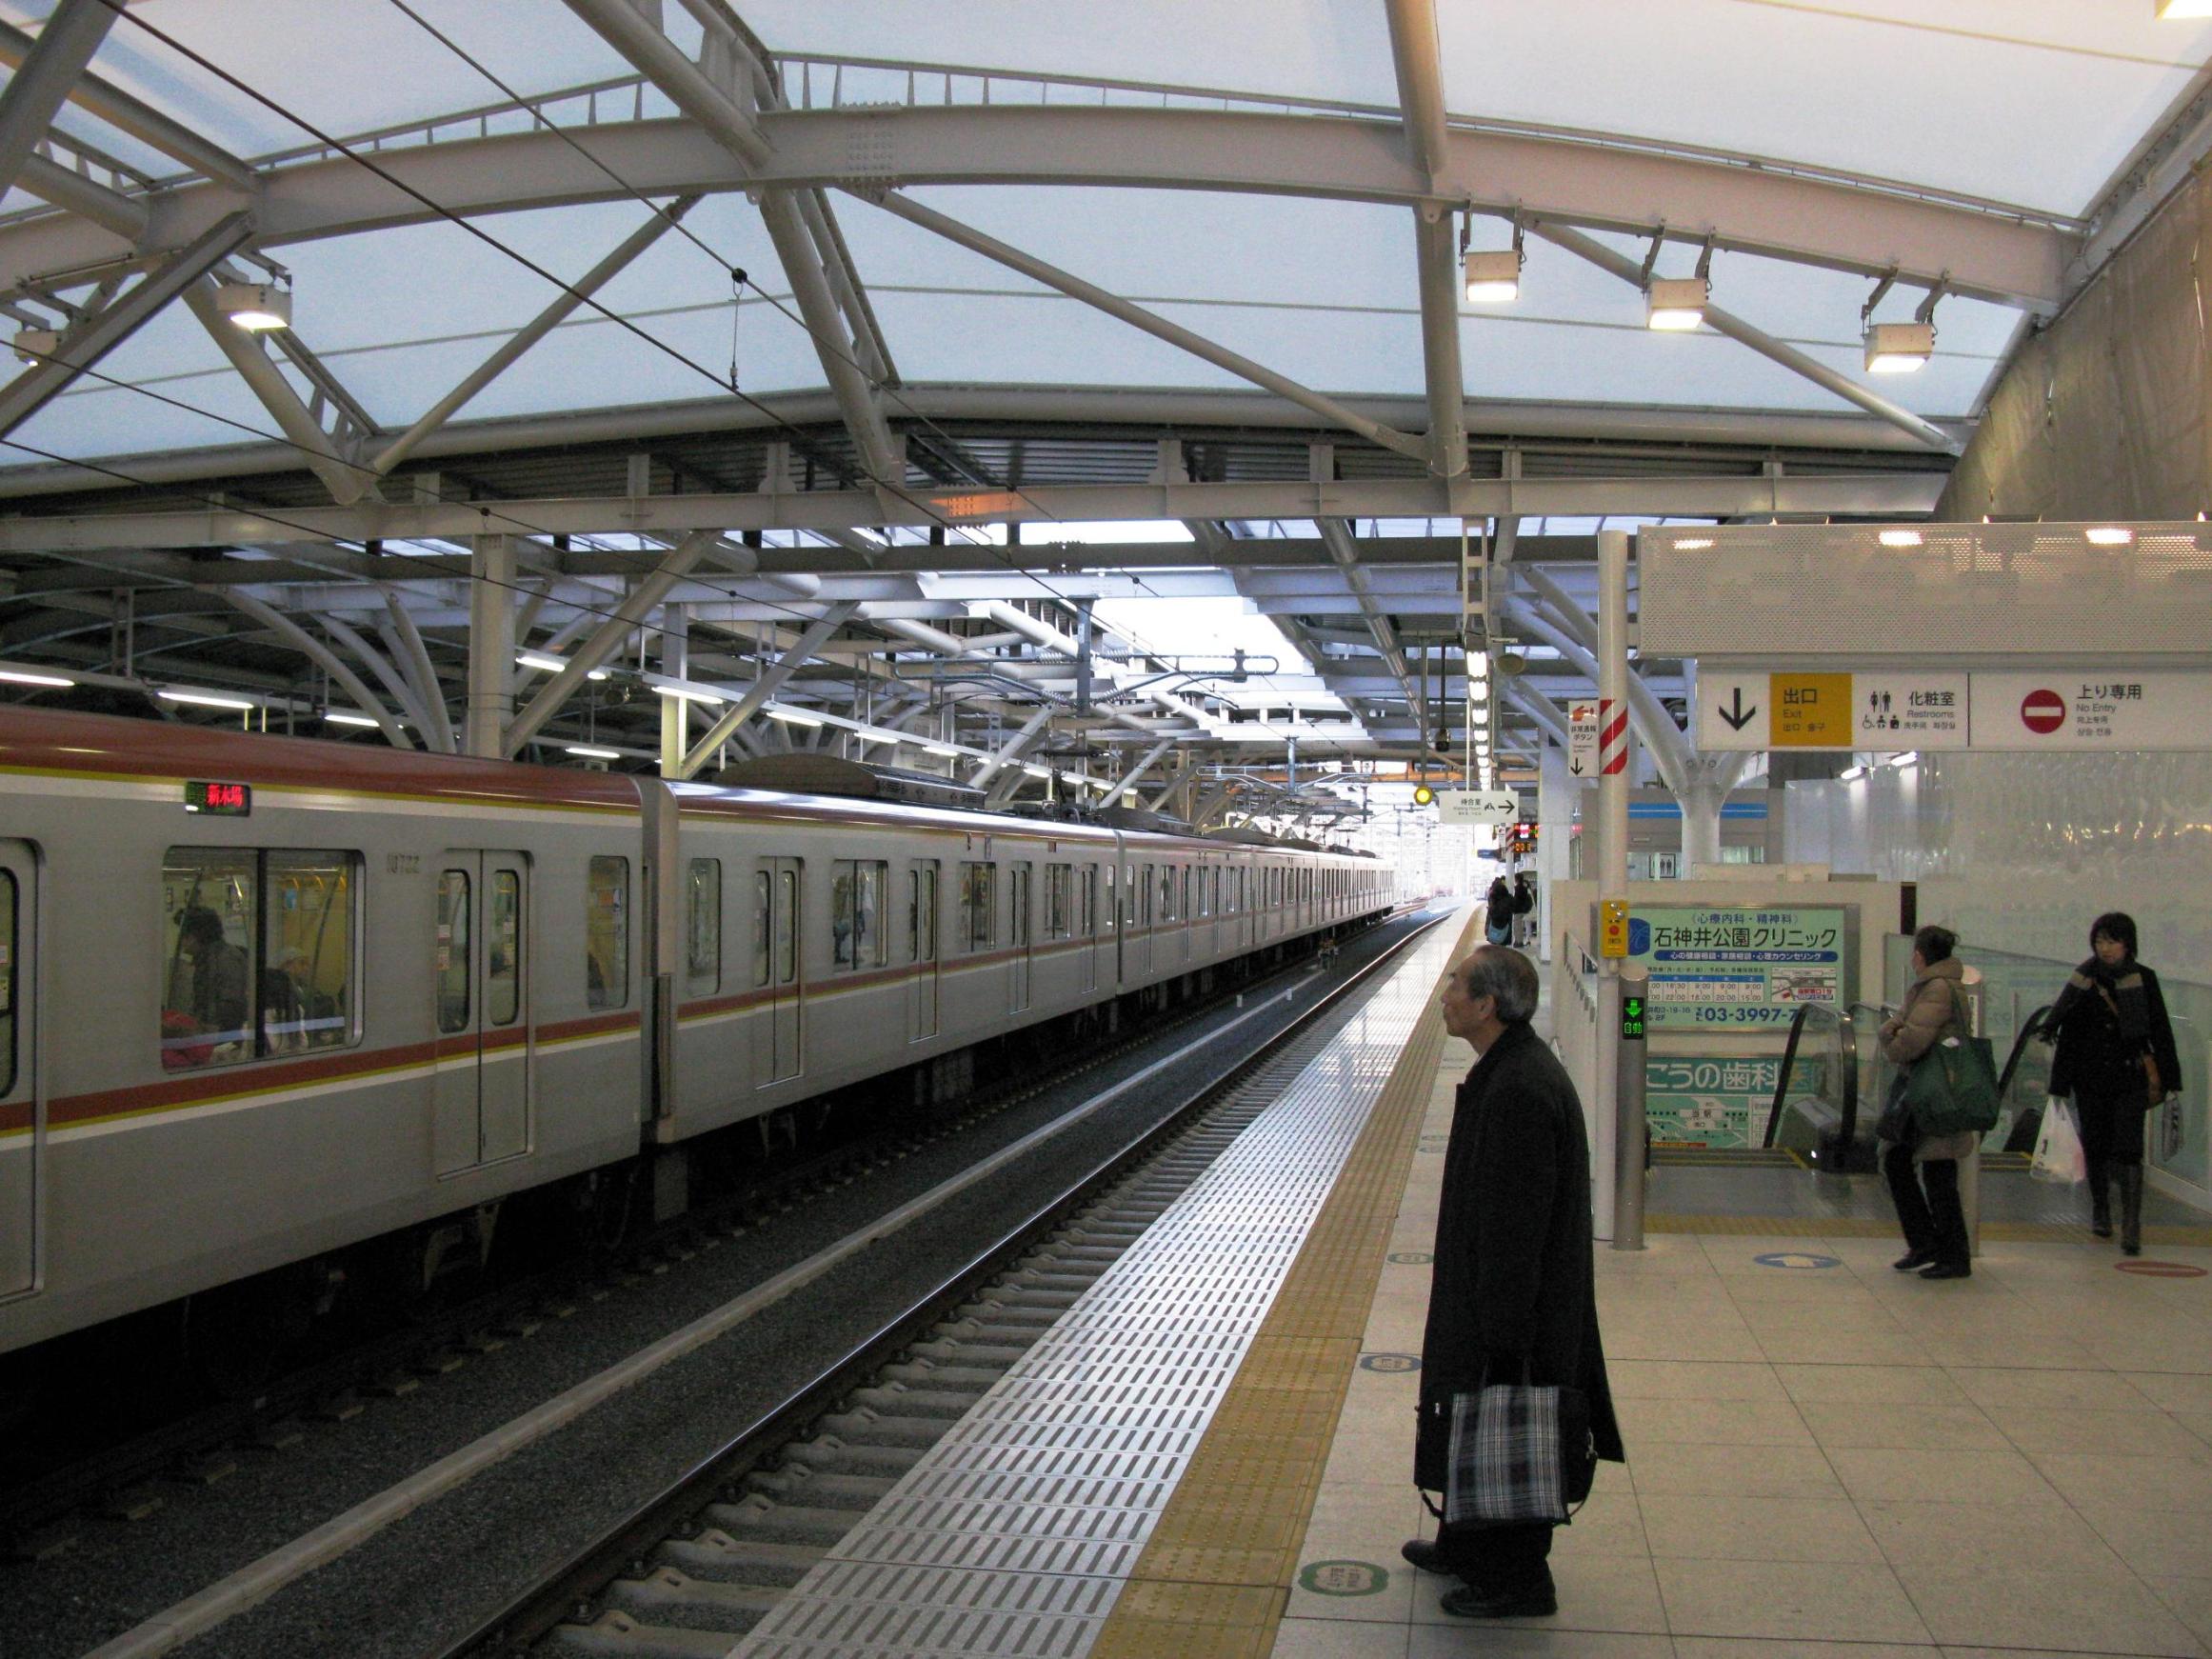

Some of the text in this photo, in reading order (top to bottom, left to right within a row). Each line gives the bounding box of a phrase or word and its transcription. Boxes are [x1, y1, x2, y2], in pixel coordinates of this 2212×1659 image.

[1784, 687, 1818, 705] 出口
[1908, 691, 1956, 707] 化粧室
[2077, 684, 2142, 700] 上り専用
[1784, 709, 1802, 719] Exit
[1906, 710, 1955, 719] Restrooms
[2077, 704, 2116, 714] No Entry
[206, 783, 244, 808] 新木場
[1654, 927, 1837, 948] 石神井公園クリニック
[1646, 1062, 1779, 1090] こうの歯科
